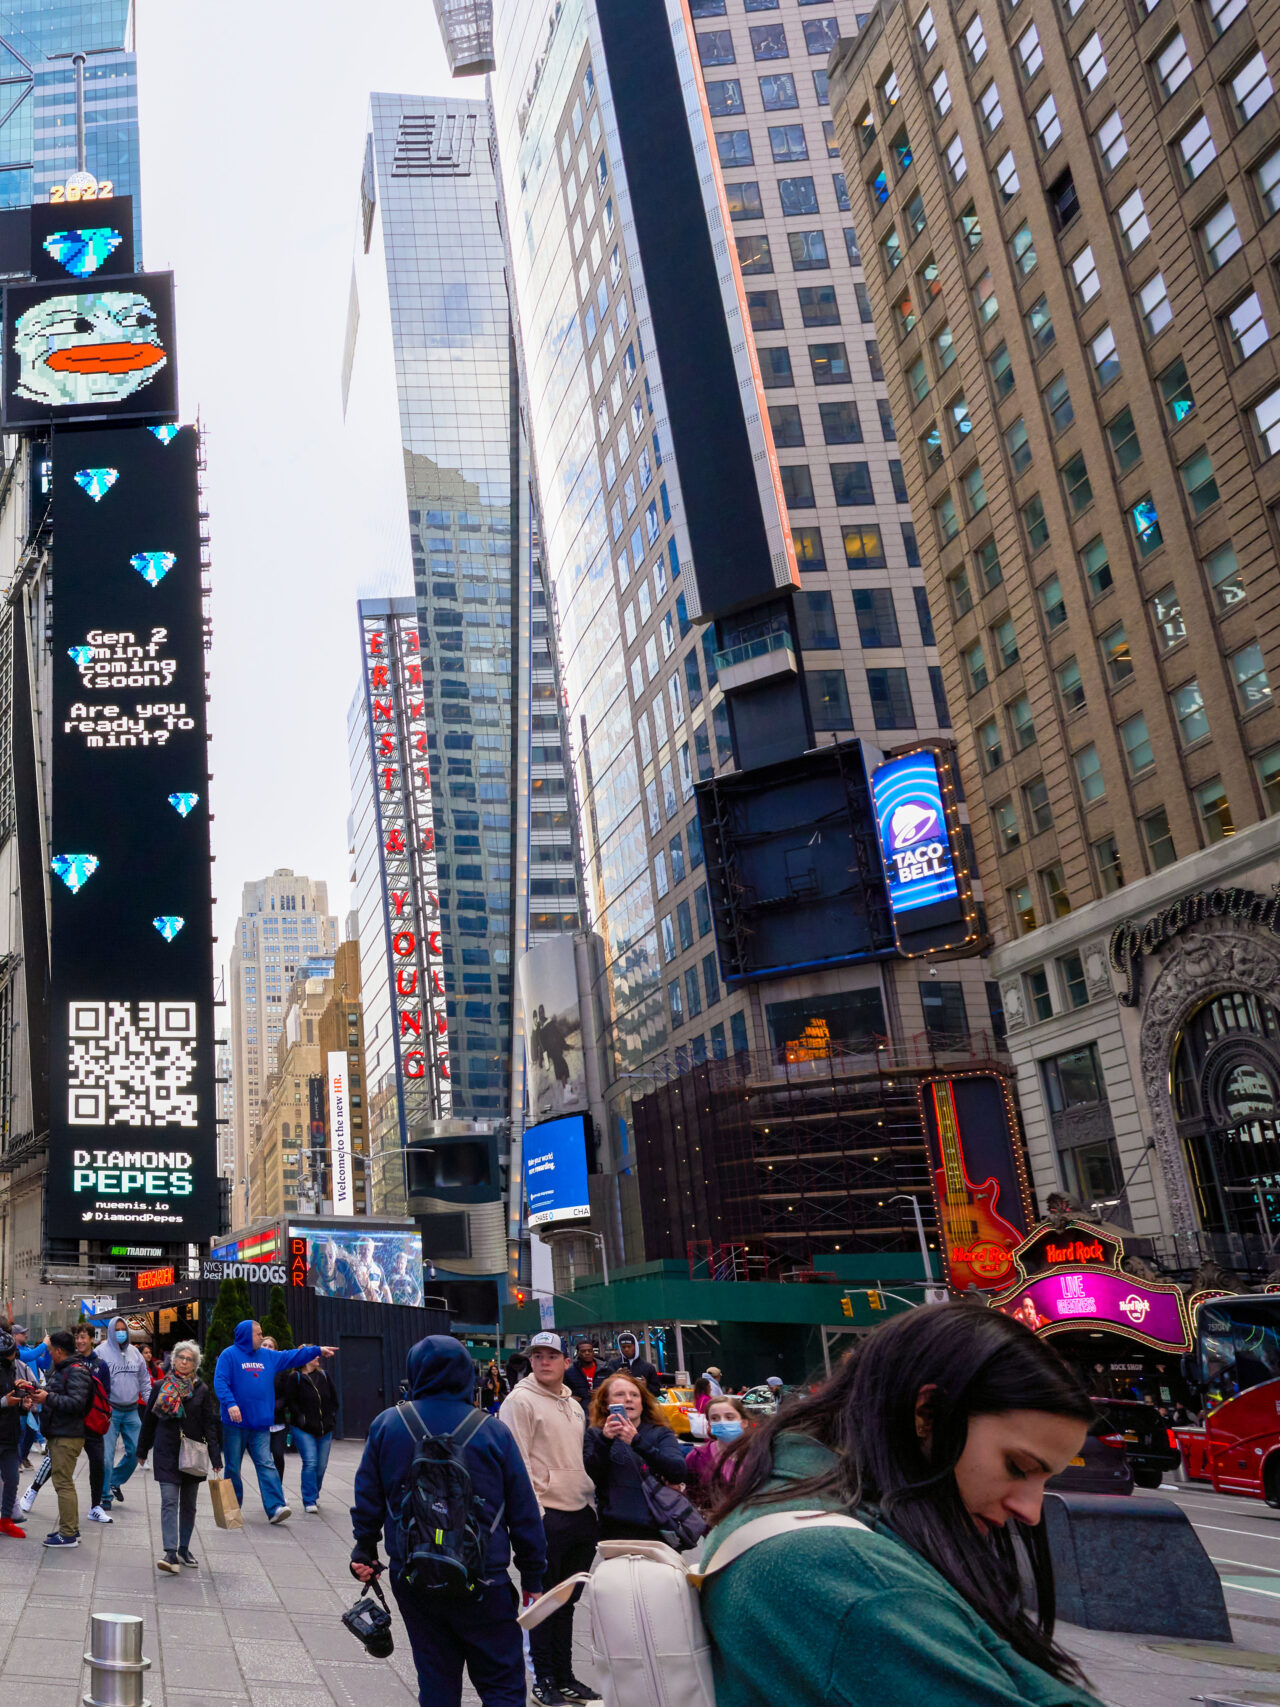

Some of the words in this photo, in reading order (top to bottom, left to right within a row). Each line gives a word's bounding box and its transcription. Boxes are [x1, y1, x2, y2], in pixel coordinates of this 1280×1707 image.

[50, 180, 114, 204] 2022
[86, 630, 135, 645] Gen
[151, 627, 168, 643] 2
[94, 642, 160, 659] mint
[79, 657, 177, 674] coming
[82, 671, 173, 688] (soon)
[70, 703, 120, 718] Are
[136, 703, 186, 718] you
[369, 632, 398, 790] ERNST
[64, 716, 145, 733] ready
[164, 715, 195, 730] to
[87, 730, 170, 747] mint?
[385, 828, 406, 851] &
[892, 843, 943, 868] TACO
[898, 858, 947, 883] BELL
[392, 891, 425, 1078] YOUNG
[336, 1096, 344, 1117] new
[335, 1120, 344, 1138] the
[338, 1140, 345, 1151] to
[74, 1150, 193, 1169] DIAMOND
[73, 1169, 193, 1195] PEPES
[338, 1156, 346, 1202] Welcome
[95, 1201, 170, 1211] nueenis.io
[573, 1208, 590, 1216] CHA
[95, 1212, 184, 1224] DiamondPepes
[952, 1247, 987, 1262] Hard
[988, 1247, 1014, 1264] Roc
[1046, 1242, 1074, 1263] Hard
[1075, 1239, 1105, 1264] Rock
[292, 1239, 305, 1287] BAR
[137, 1265, 175, 1290] BEERGARDEN
[203, 1270, 222, 1280] best
[223, 1262, 287, 1284] HOTDOGS
[1060, 1275, 1086, 1299] LIVE
[1119, 1301, 1134, 1311] Hard
[1134, 1299, 1151, 1312] Rock
